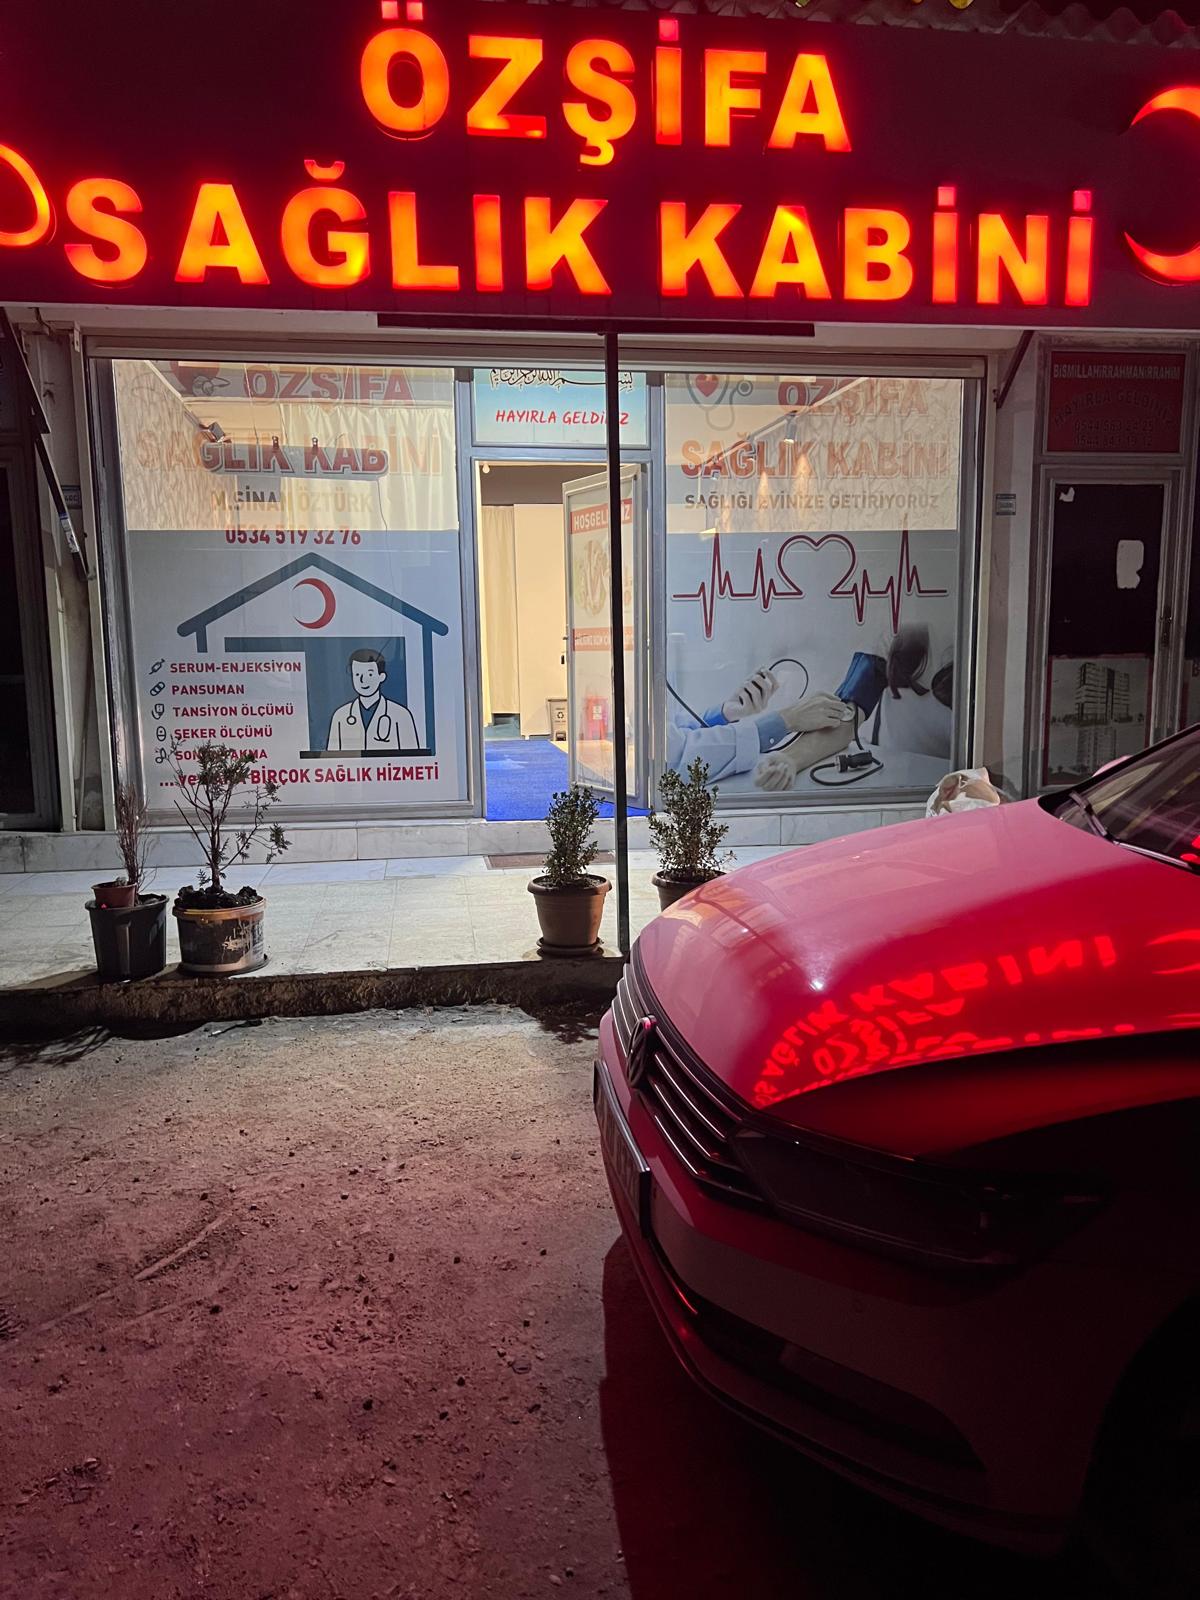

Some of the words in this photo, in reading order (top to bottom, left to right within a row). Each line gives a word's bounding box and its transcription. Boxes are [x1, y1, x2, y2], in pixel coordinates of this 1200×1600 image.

[360, 0, 852, 166] ÖZŞİFA
[64, 158, 611, 295] SAĞLIK
[660, 186, 1094, 307] KABİNİ
[495, 409, 556, 424] HAYIRLA
[562, 410, 629, 425] GELDİZ
[685, 491, 753, 509] SAĞLIĞI
[829, 491, 939, 509] GETİRİYORUZ
[225, 525, 270, 545] 0534
[276, 525, 308, 545] 519
[314, 525, 335, 545] 32
[339, 525, 361, 545] 76
[170, 659, 302, 673] SERUM-ENJEKSİYON
[171, 684, 245, 695] PANSUMAN
[173, 703, 235, 717] TANSİYON
[241, 702, 294, 718] ÖLÇÜMÜ
[174, 727, 217, 740] ŞEKER
[220, 725, 273, 740] ÖLÇÜMÜ
[251, 765, 310, 786] BİRÇOK
[314, 764, 372, 783] SAĞLIK
[376, 762, 440, 782] HİZMETİ
